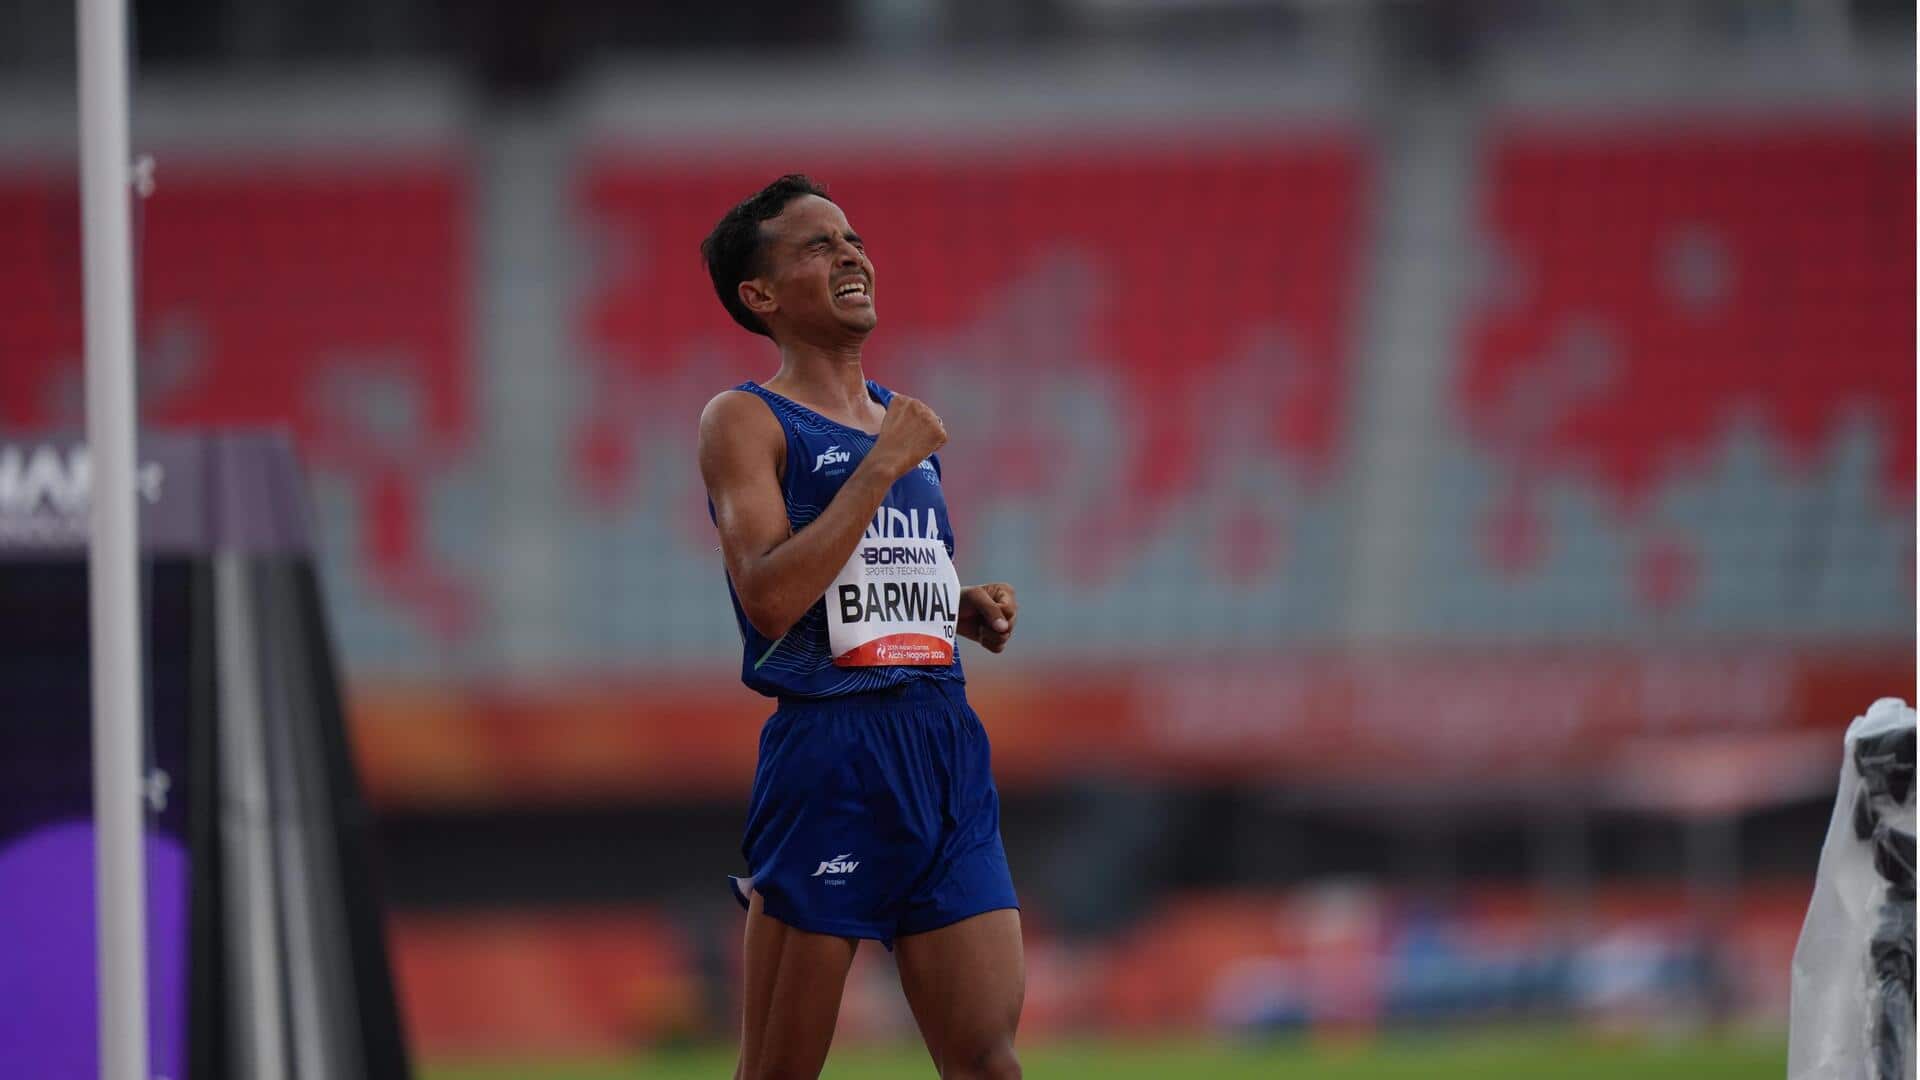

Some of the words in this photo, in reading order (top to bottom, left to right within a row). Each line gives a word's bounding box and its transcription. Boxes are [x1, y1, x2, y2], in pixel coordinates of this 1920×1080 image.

[811, 451, 851, 473] JSW
[863, 505, 940, 540] NDIA
[863, 546, 937, 565] BORNAN
[865, 566, 894, 576] SPORTS
[838, 582, 957, 624] BARWAL
[810, 860, 860, 876] JSW
